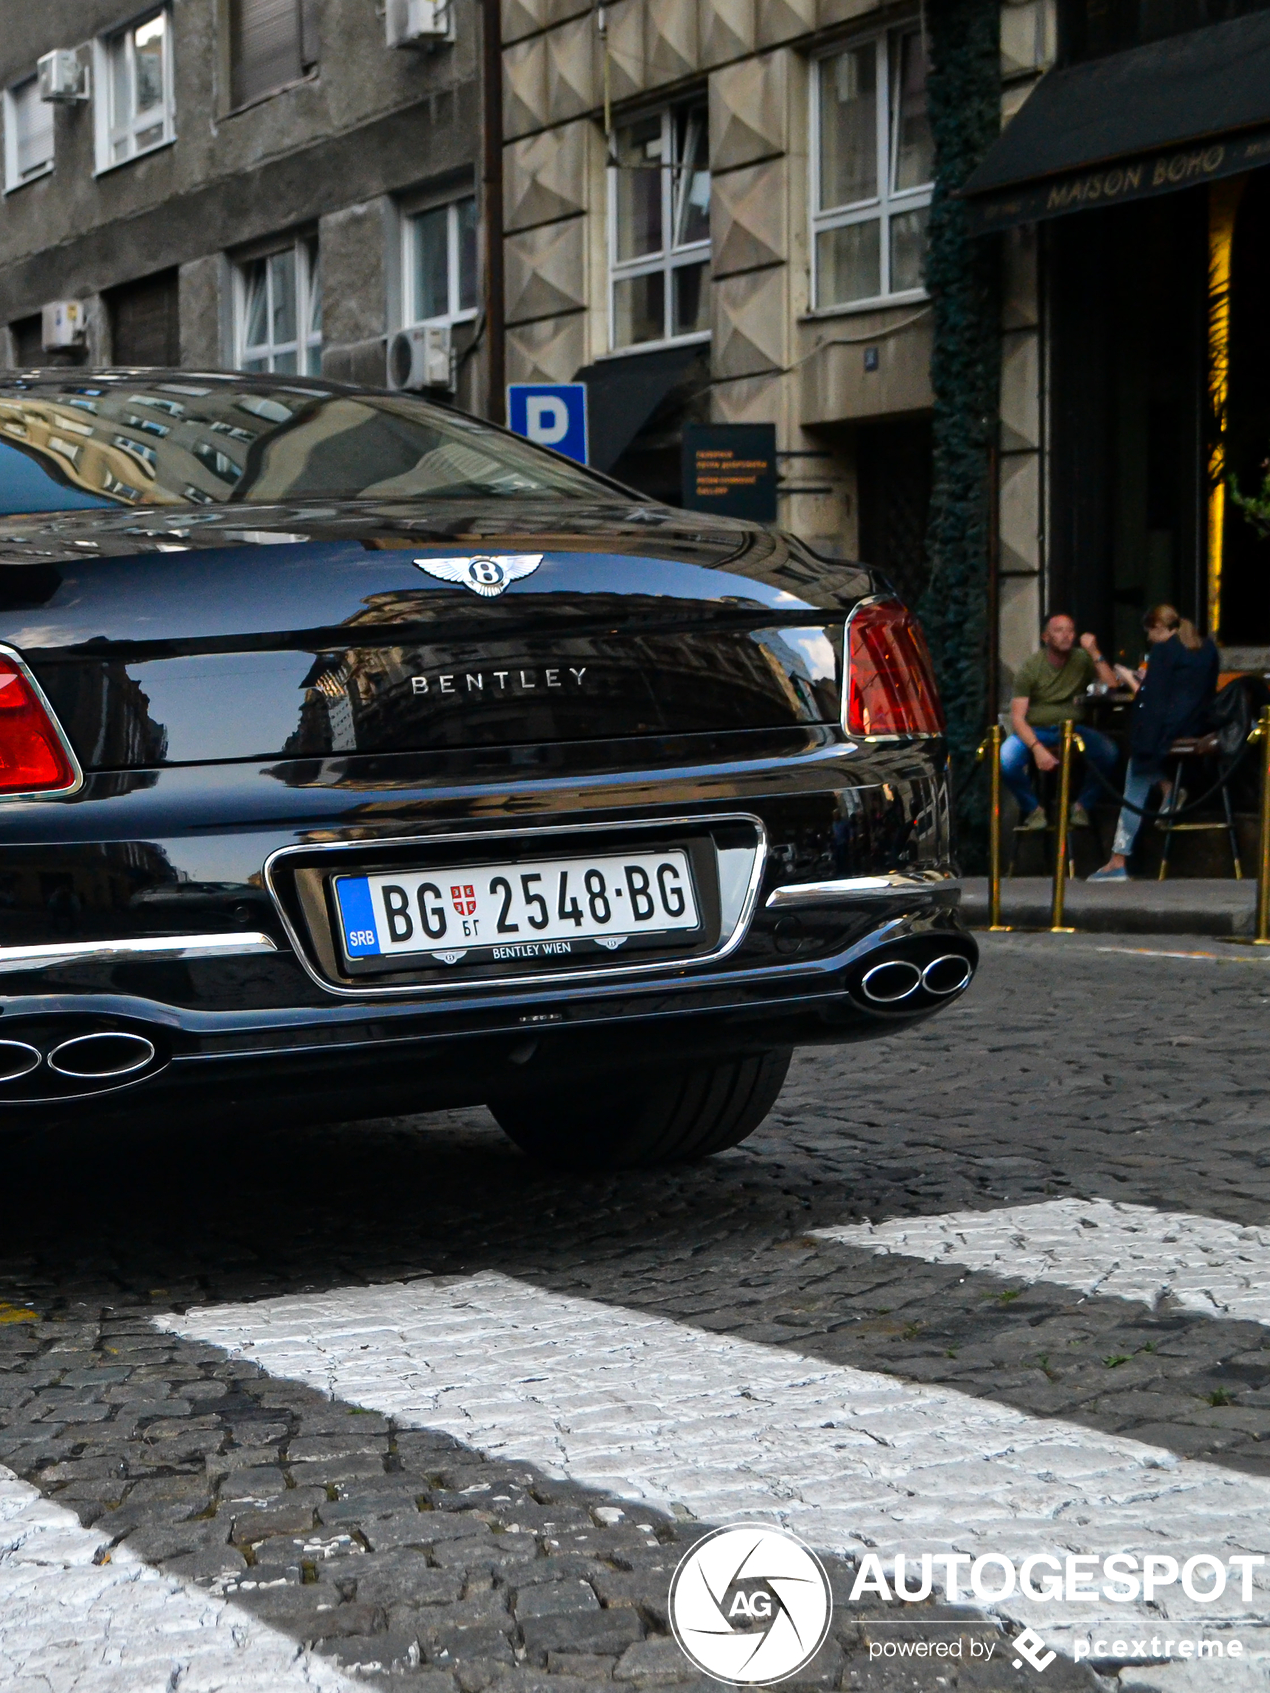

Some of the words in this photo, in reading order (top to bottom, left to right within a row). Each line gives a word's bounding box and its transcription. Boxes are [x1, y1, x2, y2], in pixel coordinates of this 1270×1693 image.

[1047, 166, 1143, 209] MAISON
[1152, 145, 1225, 186] BOHO
[412, 667, 586, 694] BENTLEY
[382, 882, 447, 942] BG
[350, 930, 375, 946] SRB
[493, 942, 539, 960] BENTLEY
[542, 941, 571, 955] WIEN
